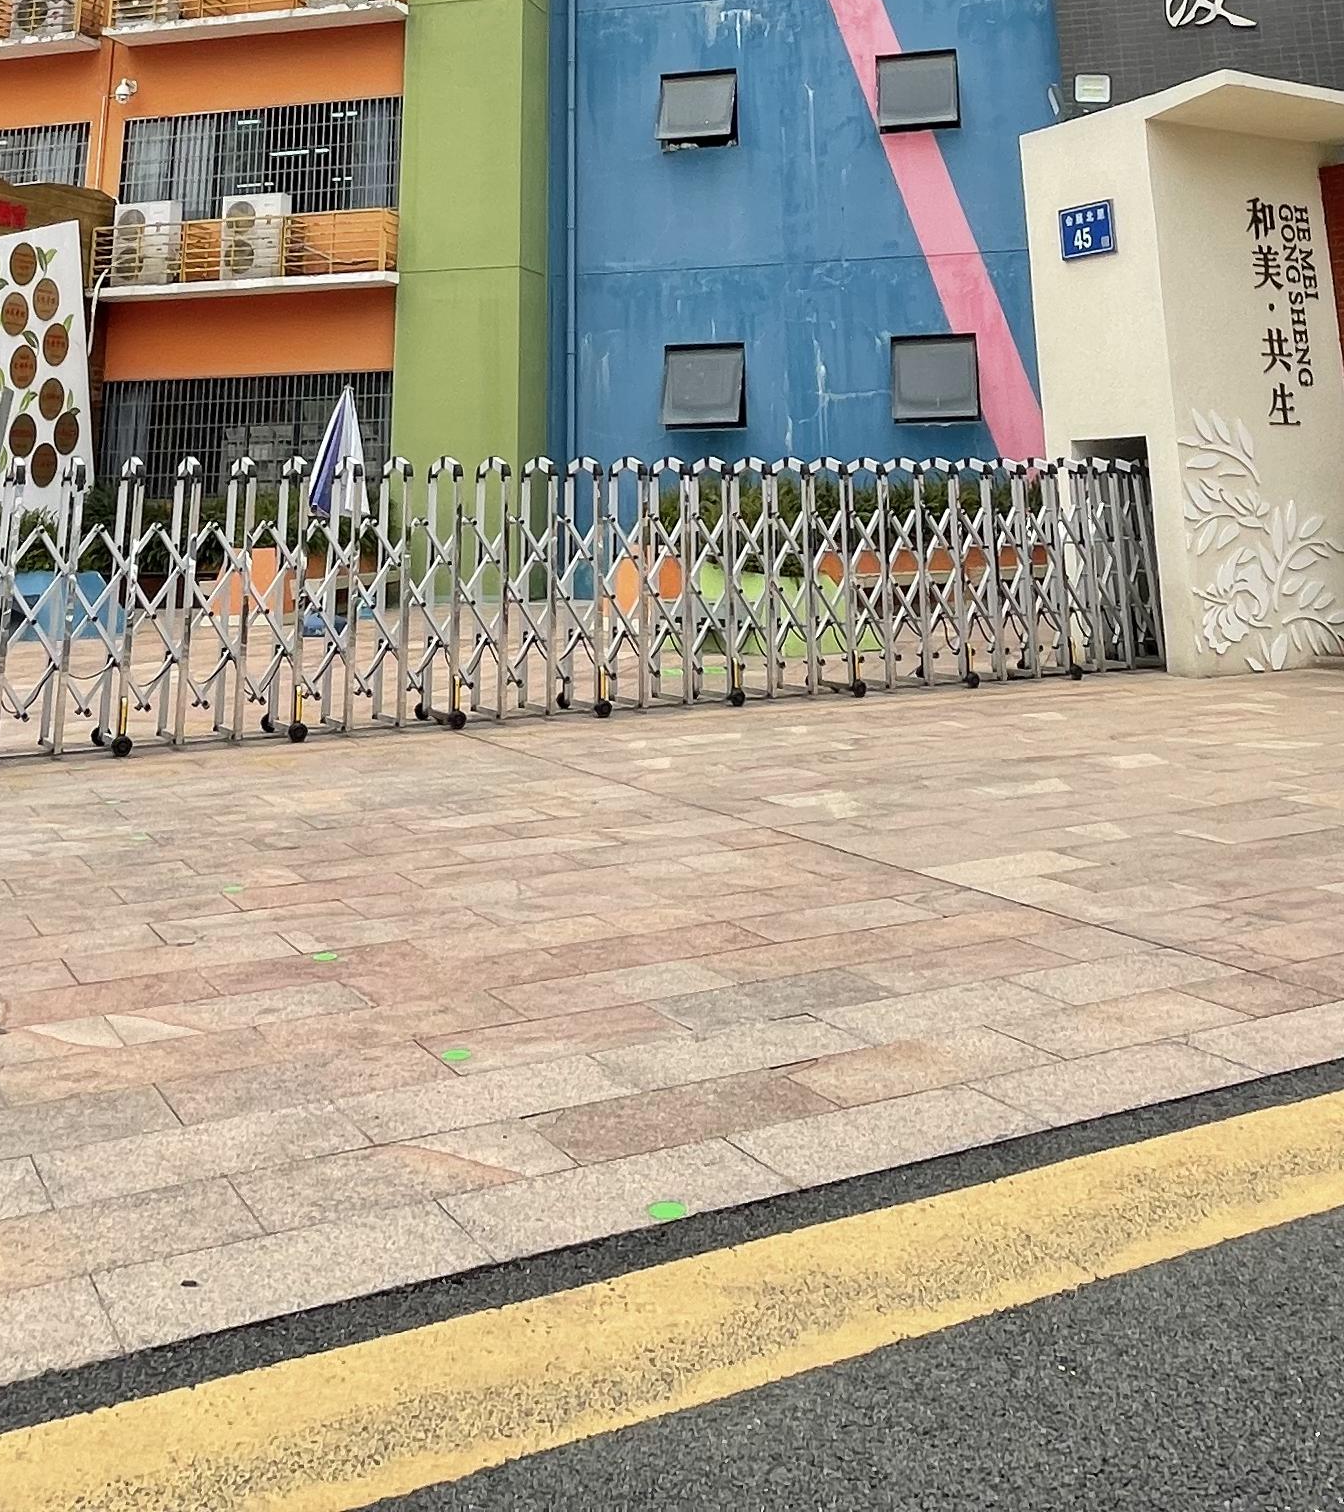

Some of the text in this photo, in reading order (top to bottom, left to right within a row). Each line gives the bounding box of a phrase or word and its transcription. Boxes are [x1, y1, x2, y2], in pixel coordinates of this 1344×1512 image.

[1073, 227, 1092, 250] 45
[1293, 205, 1319, 300] HE MEI
[1278, 203, 1314, 388] GONG SHENG
